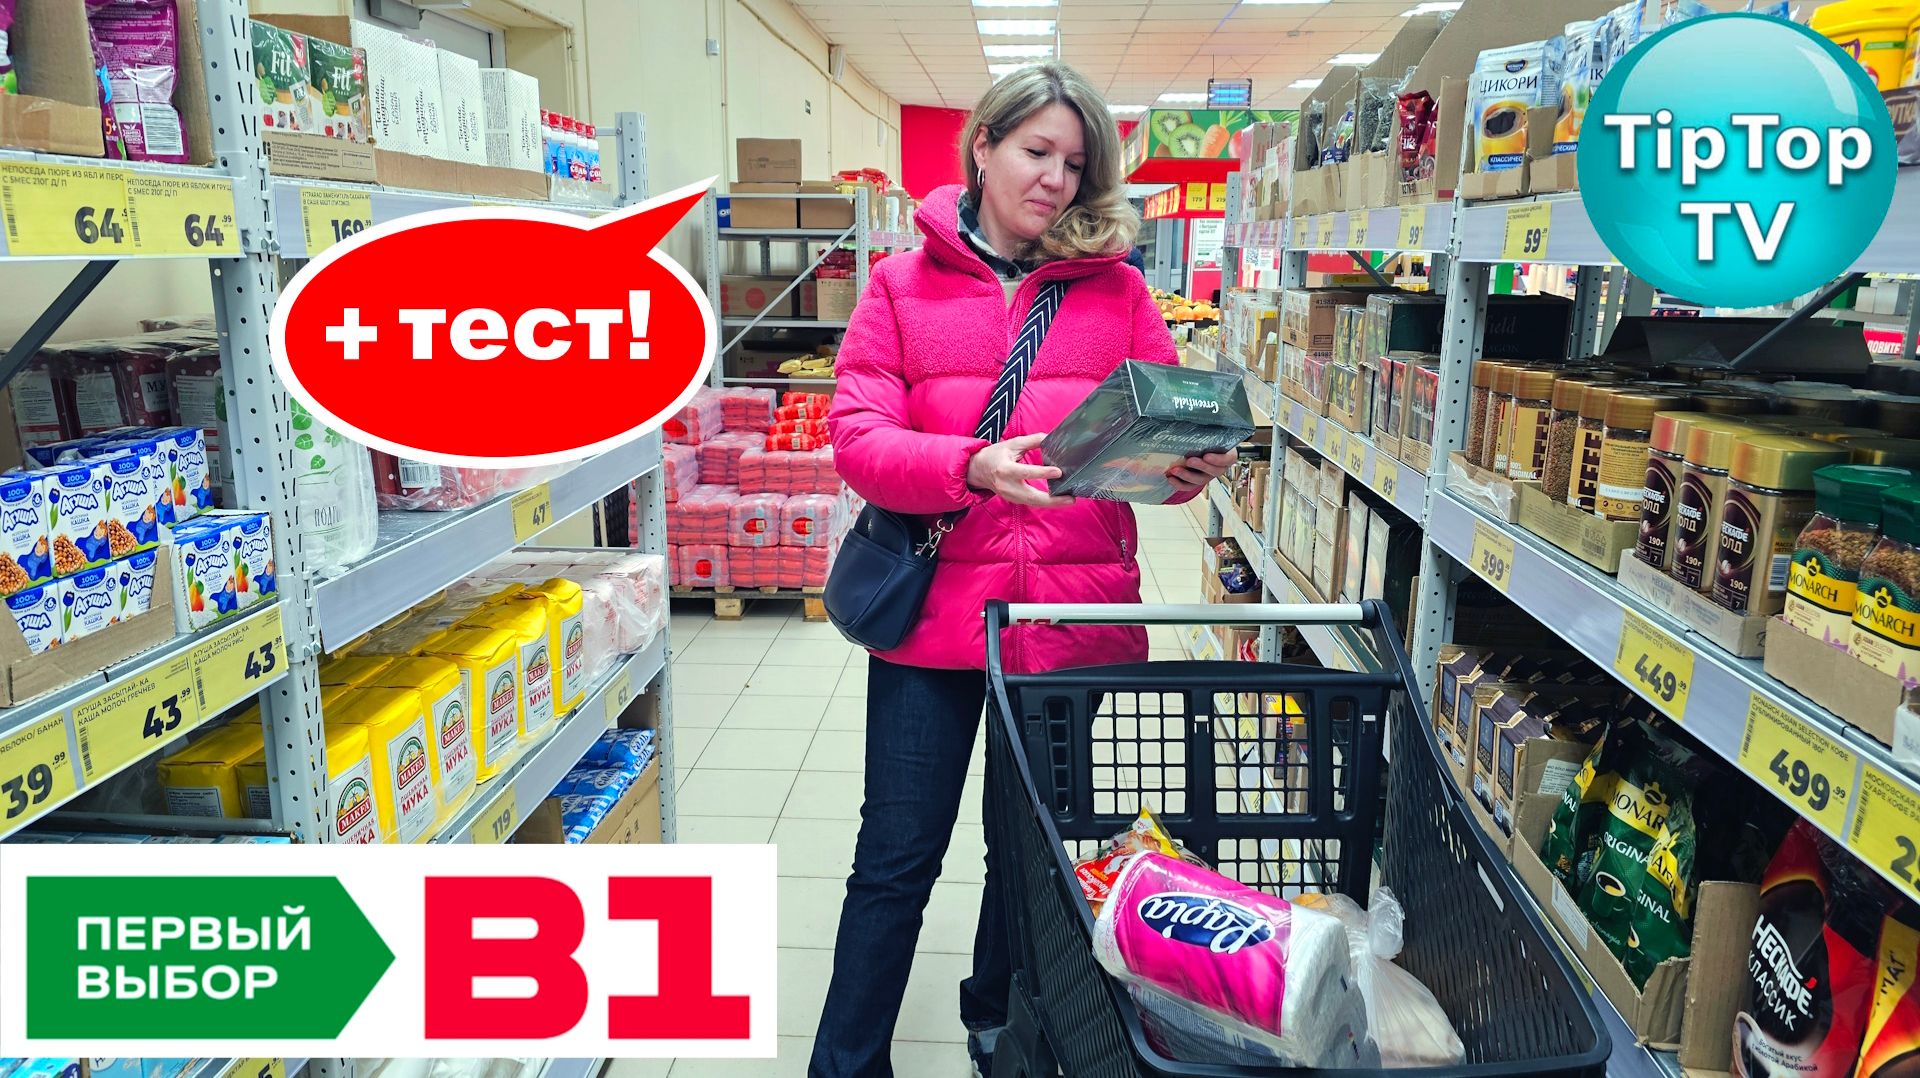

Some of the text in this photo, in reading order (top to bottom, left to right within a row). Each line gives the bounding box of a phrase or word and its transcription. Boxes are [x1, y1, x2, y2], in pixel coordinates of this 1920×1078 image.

[2, 165, 46, 176] НЕПОСЕДА
[48, 168, 71, 177] ПЮРЕ
[72, 170, 82, 178] ИЗ
[83, 171, 98, 179] ЯБЛ
[99, 172, 104, 180] И
[127, 179, 161, 188] НЕПОСЕДА
[162, 180, 180, 189] ПЮРЕ
[181, 180, 189, 189] ИЗ
[191, 182, 210, 190] ЯБЛОК
[75, 206, 124, 244] 64
[184, 213, 225, 248] 64
[1409, 226, 1419, 244] 99
[1524, 228, 1541, 253] 59
[1173, 396, 1219, 413] Greenfield
[66, 474, 84, 482] 100%
[119, 462, 135, 470] 100%
[7, 488, 25, 497] 100%
[1383, 476, 1392, 495] 89
[136, 557, 150, 566] 100%
[1481, 548, 1504, 582] 399
[81, 574, 99, 583] 100%
[1789, 573, 1838, 602] MONARCH
[15, 593, 35, 604] 100%
[1855, 600, 1914, 638] MONARCH
[245, 641, 275, 680] 43
[1634, 653, 1677, 703] 449
[77, 700, 102, 717] АГУША
[139, 677, 149, 687] КА
[529, 685, 551, 706] МУКА
[618, 687, 628, 706] 62
[78, 712, 100, 726] КАША
[101, 699, 126, 716] МОЛОЧ
[143, 694, 182, 739] 43
[180, 687, 190, 699] .99
[37, 717, 64, 735] БАНАН
[491, 714, 514, 737] МУКА
[1753, 694, 1849, 761] MONARCH ASIAN SELECTION КОФЕ
[445, 744, 468, 773] МУКА
[1, 751, 65, 819] 39 .99
[1769, 748, 1846, 812] 499 .99
[1863, 781, 1886, 801] СУАРЕ
[1866, 771, 1915, 807] МОСКОВСКАЯ
[402, 784, 428, 815] МУКА
[492, 809, 511, 840] 119
[1786, 1051, 1802, 1062] вкус
